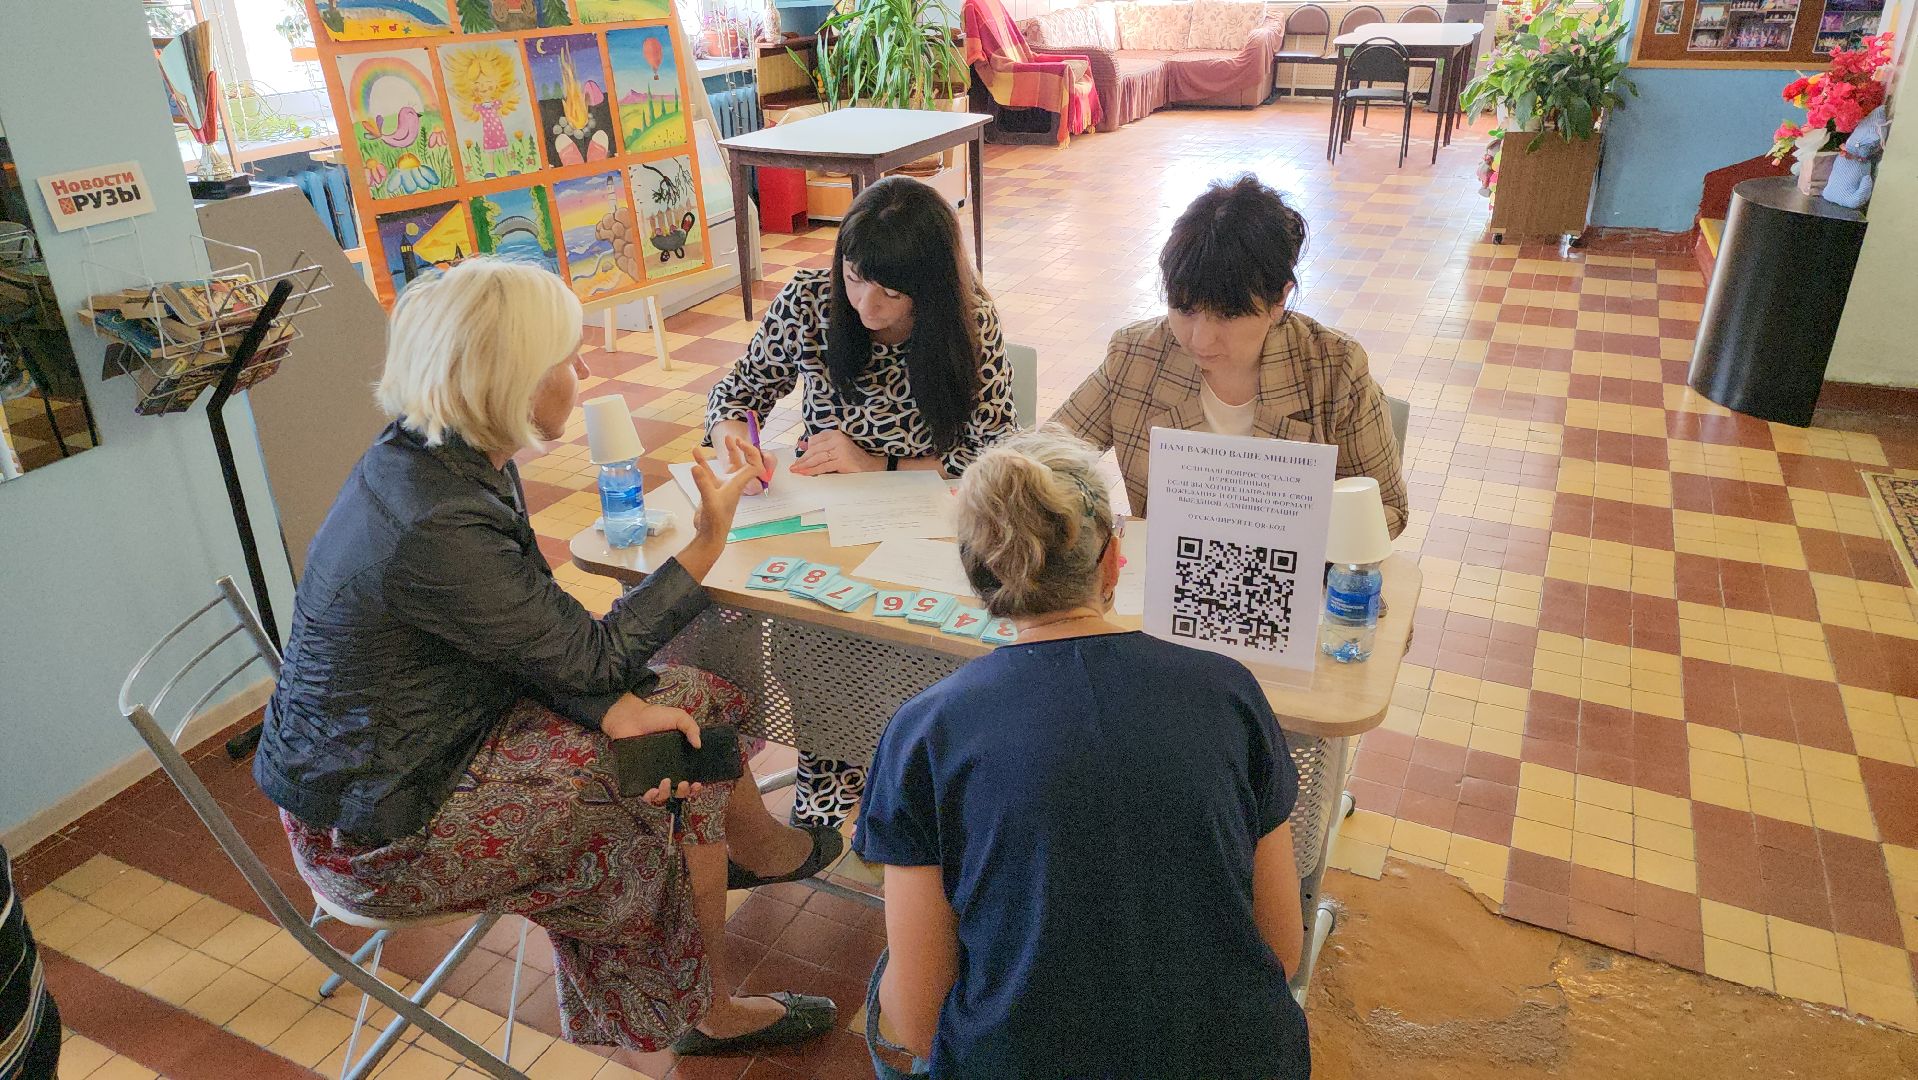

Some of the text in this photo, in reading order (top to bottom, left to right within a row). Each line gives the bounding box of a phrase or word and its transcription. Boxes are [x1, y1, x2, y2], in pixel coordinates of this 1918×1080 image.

[72, 185, 141, 212] РУЗЫ
[1187, 445, 1227, 456] ВАЖНО
[1229, 450, 1260, 460] ВАШЕ
[1263, 453, 1317, 466] МНЕНИЕ!
[803, 569, 827, 584] 8
[826, 586, 854, 600] 7
[912, 597, 938, 612] 5
[953, 612, 978, 629] 4
